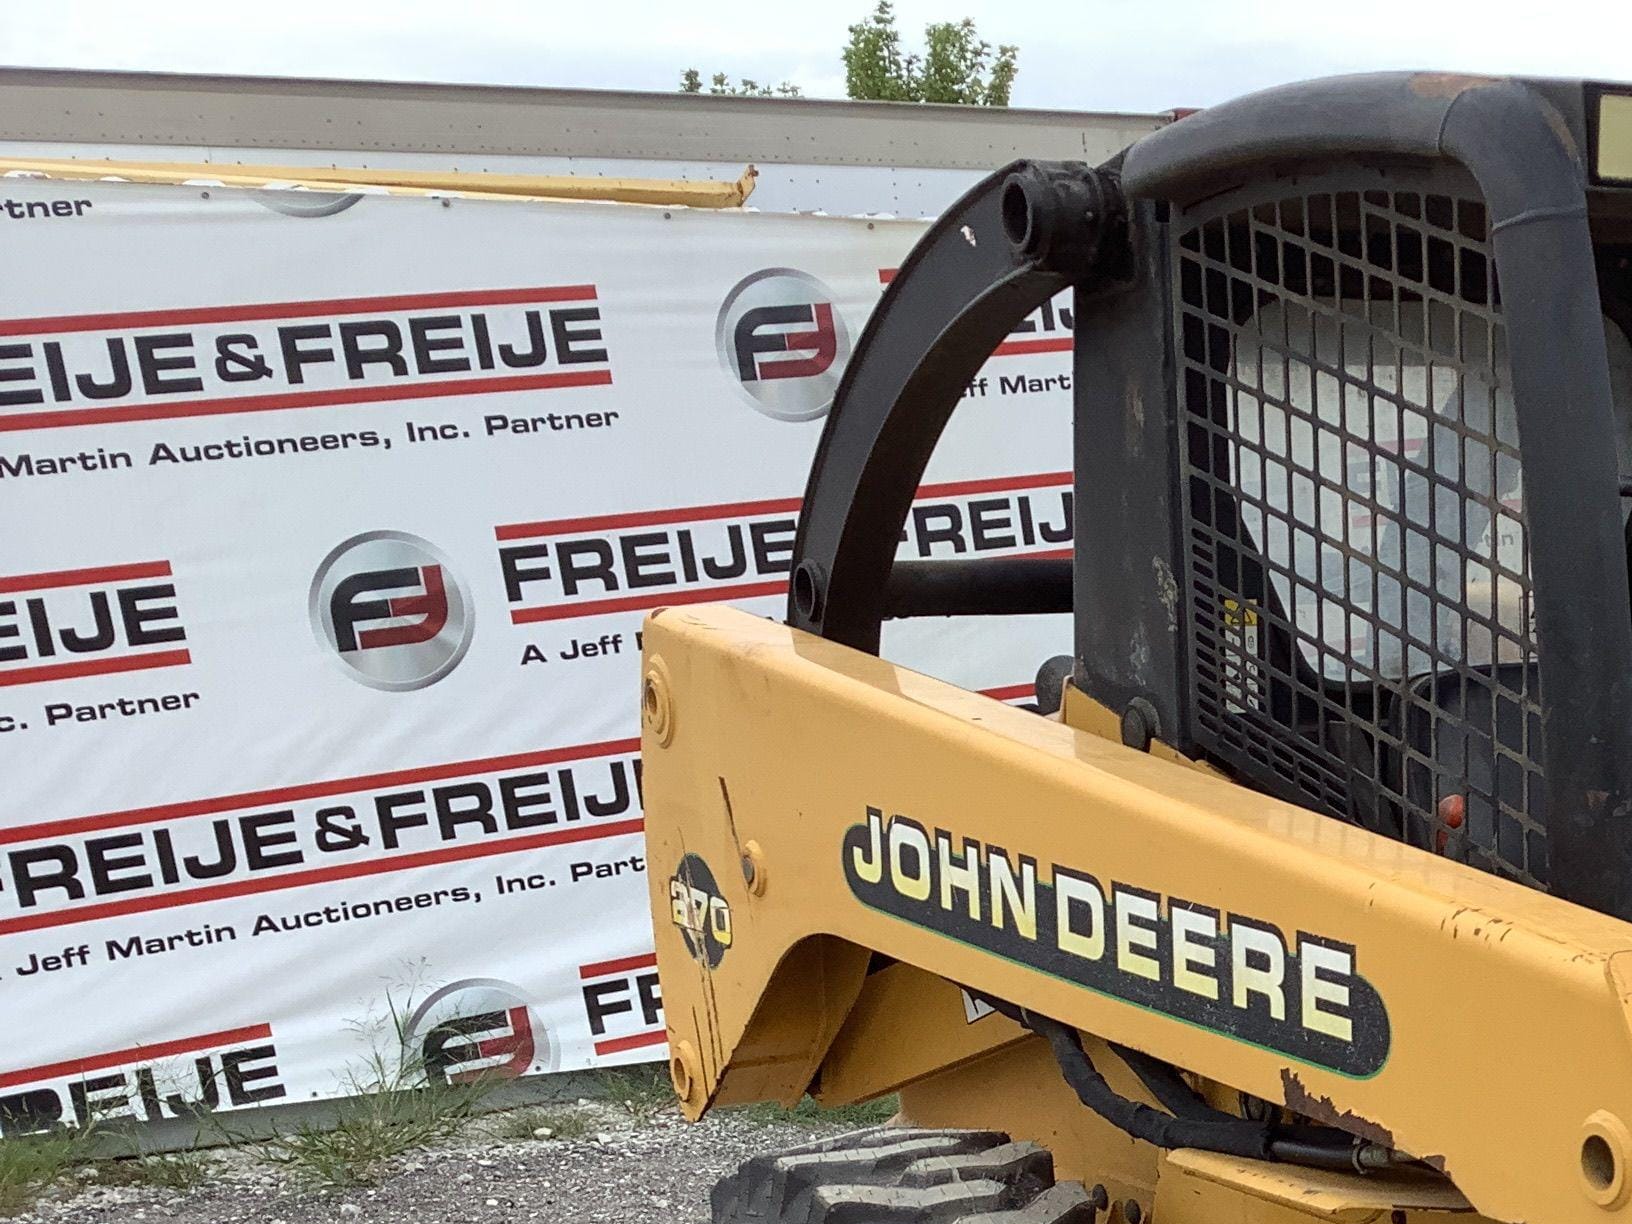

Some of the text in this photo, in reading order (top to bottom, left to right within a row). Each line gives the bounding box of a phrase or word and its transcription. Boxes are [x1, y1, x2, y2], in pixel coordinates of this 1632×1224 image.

[0, 199, 93, 219] tner
[999, 374, 1073, 396] Mart
[0, 410, 620, 479] Martin Auctioneers, Inc. Partner
[899, 491, 1074, 558] REIJ
[498, 518, 798, 603] FREIJE
[520, 643, 548, 667] A
[559, 633, 624, 661] Jeff
[45, 691, 201, 727] Partner
[15, 944, 91, 977] Jeff
[105, 924, 237, 961] Martin
[251, 885, 482, 937] Auctioneers,
[495, 873, 557, 895] Inc.
[852, 812, 1356, 1043] JOHN DEERE
